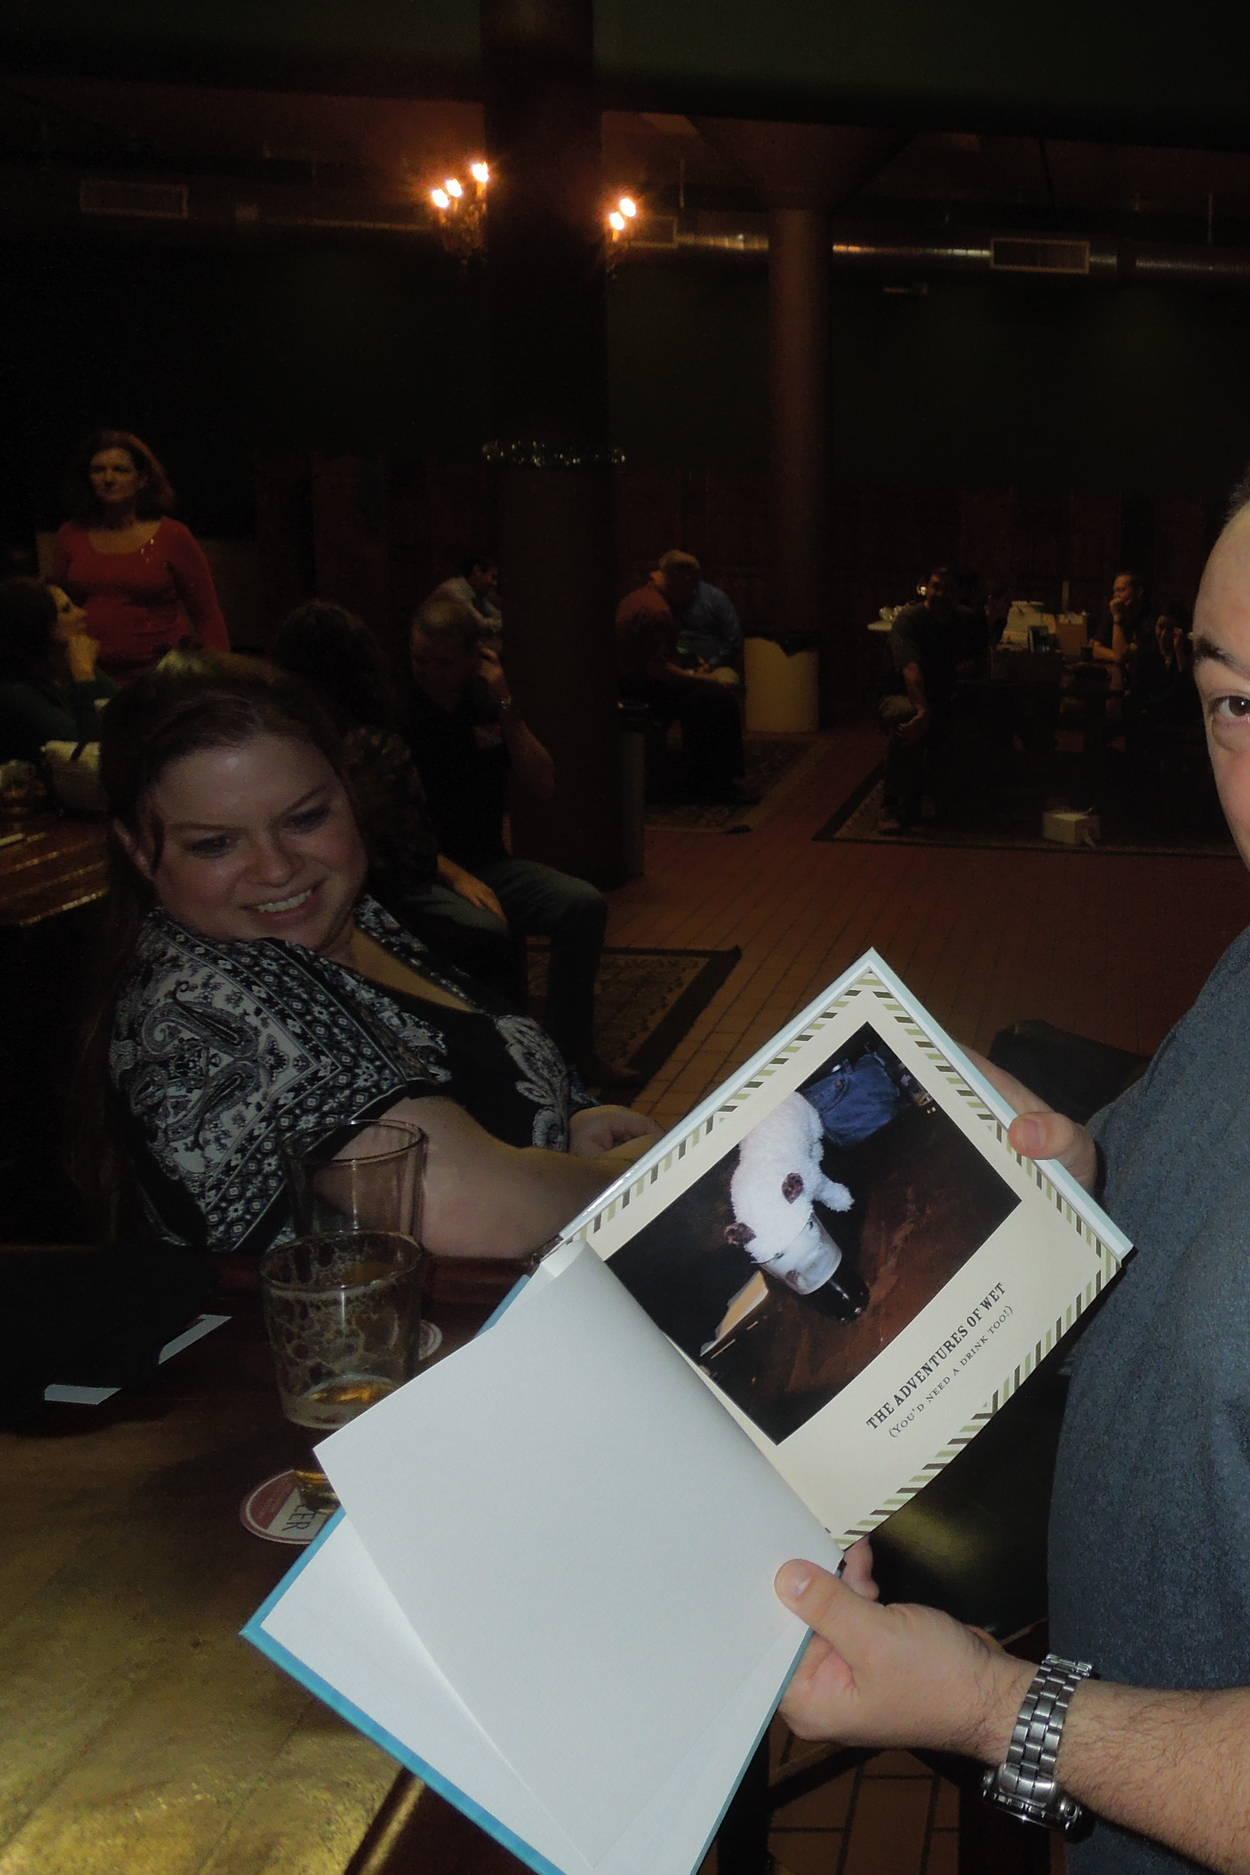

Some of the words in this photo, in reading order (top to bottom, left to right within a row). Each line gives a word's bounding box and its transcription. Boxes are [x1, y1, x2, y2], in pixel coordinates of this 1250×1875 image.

[866, 1402, 895, 1430] THE
[893, 1325, 968, 1406] ADVENTURES
[966, 1308, 982, 1328] OF
[980, 1282, 1006, 1311] WET
[925, 1376, 950, 1403] NEED
[952, 1368, 960, 1376] A
[960, 1337, 988, 1367] DRINK
[988, 1305, 1014, 1334] TOO!)
